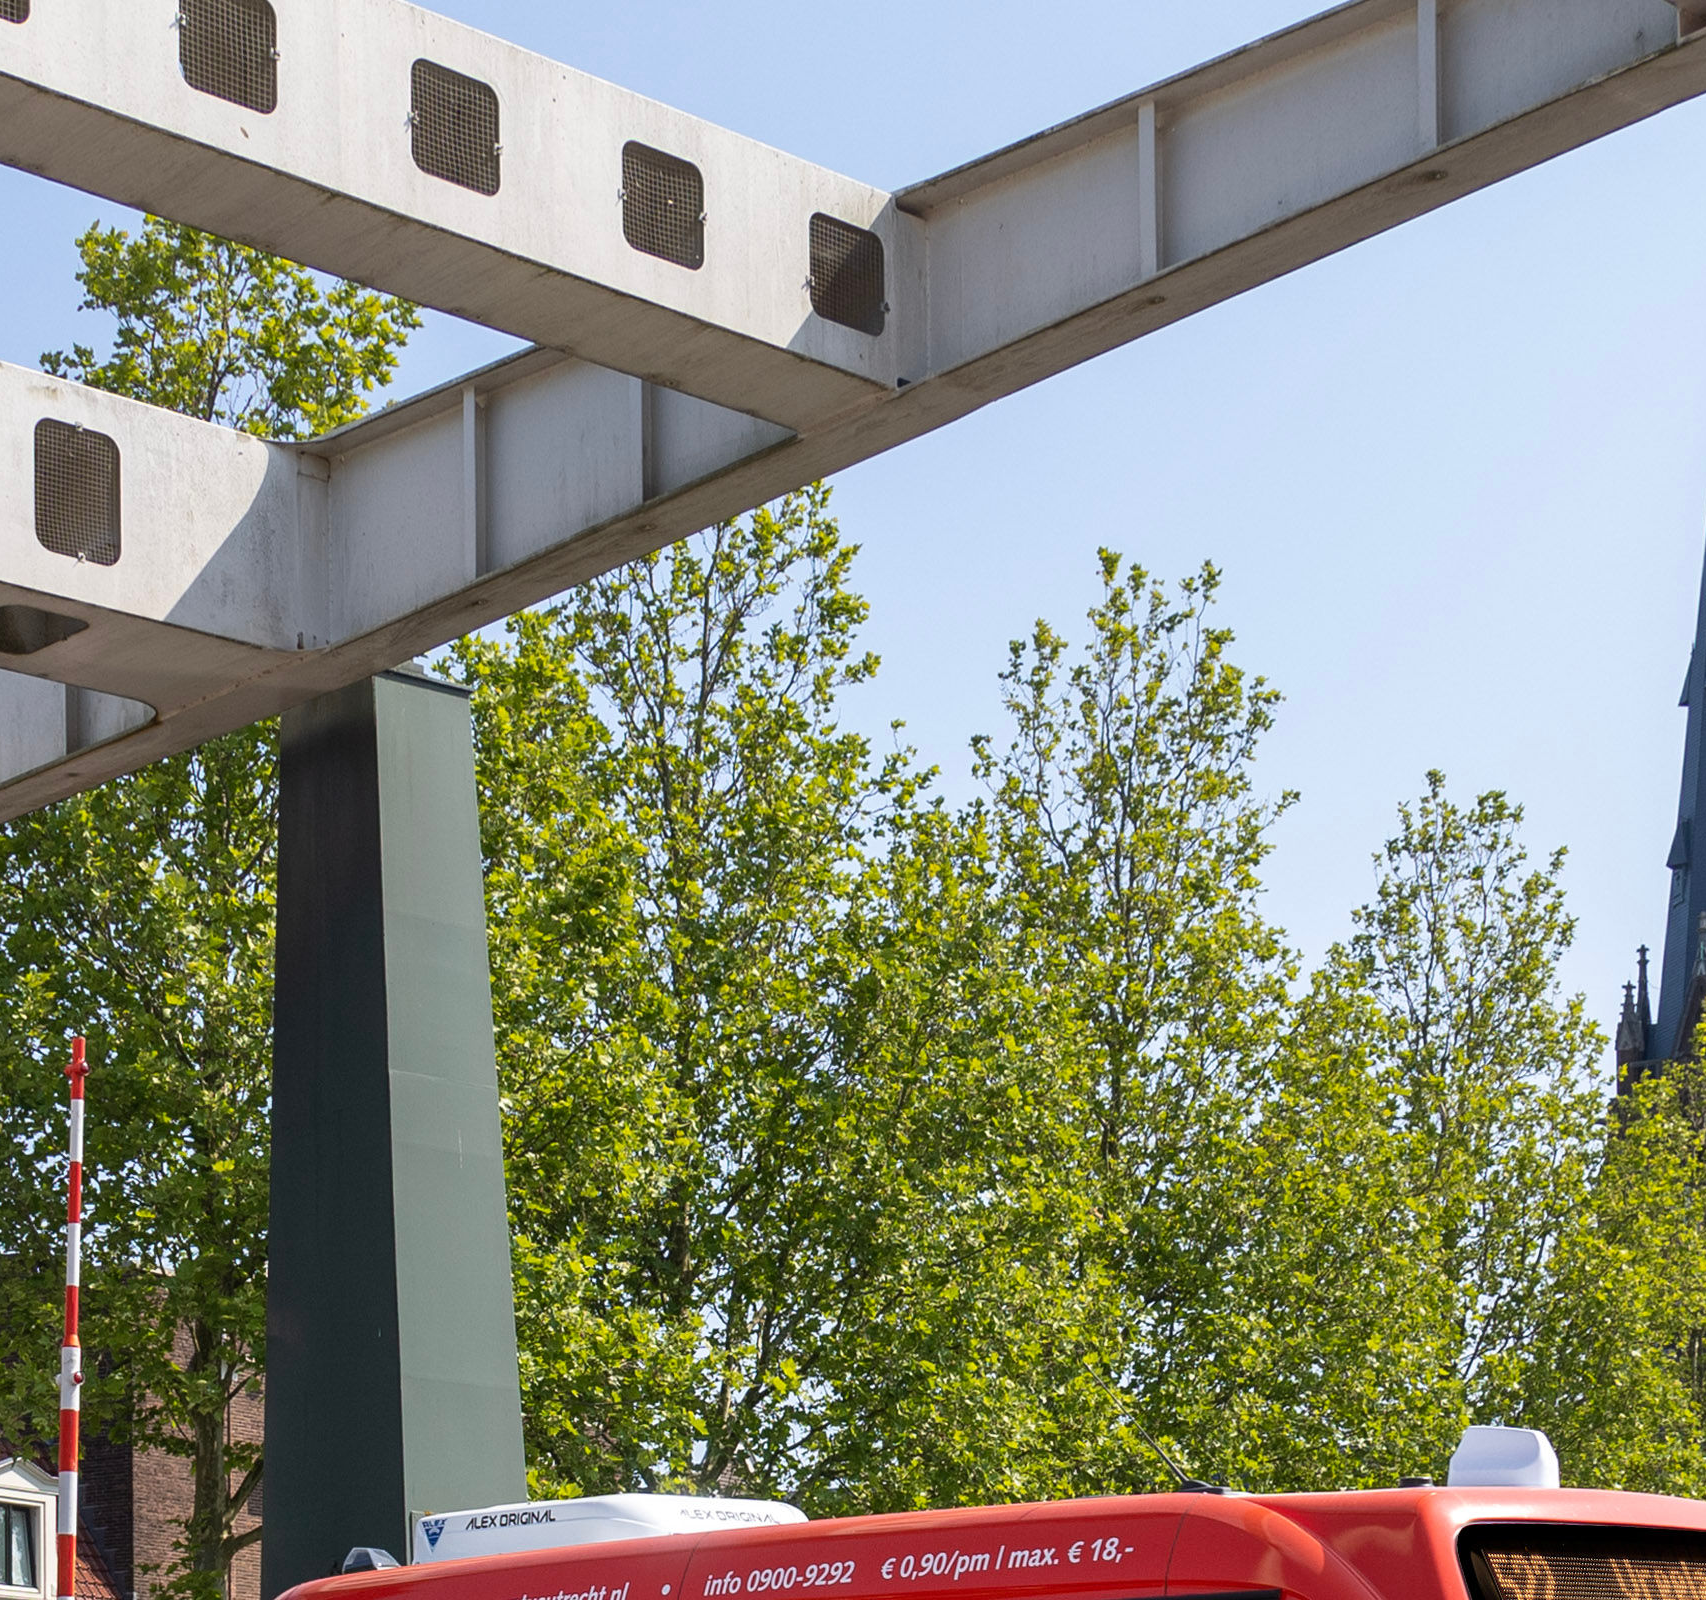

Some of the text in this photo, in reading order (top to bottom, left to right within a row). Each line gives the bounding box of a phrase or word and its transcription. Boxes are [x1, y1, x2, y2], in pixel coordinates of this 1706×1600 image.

[465, 1509, 557, 1531] ALEX ORIGINAL
[680, 1508, 782, 1525] ALEX ORIGINAL
[881, 1557, 897, 1580] €
[899, 1549, 990, 1581] 0,90/pm
[1008, 1545, 1060, 1569] max.
[1067, 1541, 1084, 1563] €
[1090, 1536, 1134, 1563] 18,-
[703, 1560, 856, 1597] info 0900-9292
